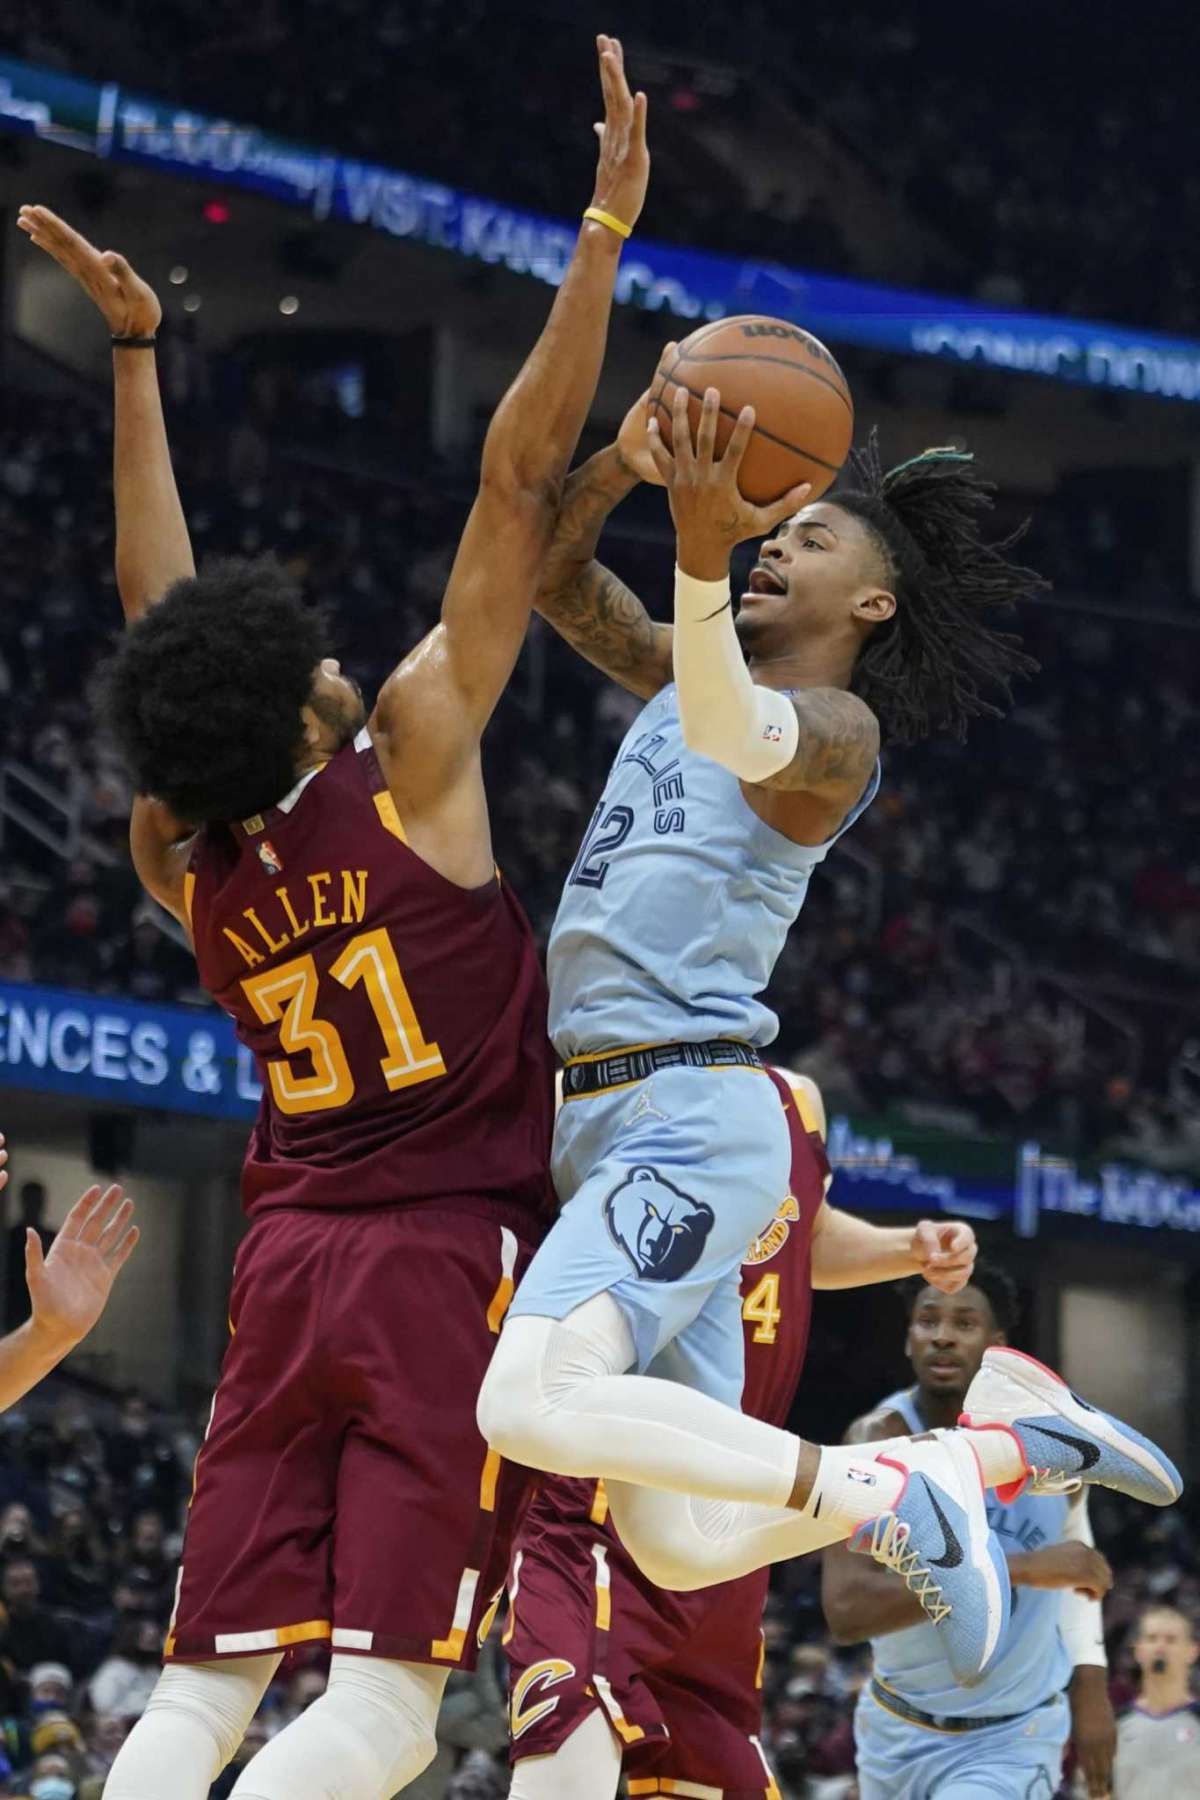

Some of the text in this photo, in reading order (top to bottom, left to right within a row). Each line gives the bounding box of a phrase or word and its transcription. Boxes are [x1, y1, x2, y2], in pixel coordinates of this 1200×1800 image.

[222, 870, 368, 968] ALLEN
[0, 1001, 169, 1086] NCES
[181, 1029, 223, 1095] &
[240, 926, 448, 1115] 31
[743, 1273, 781, 1345] 4
